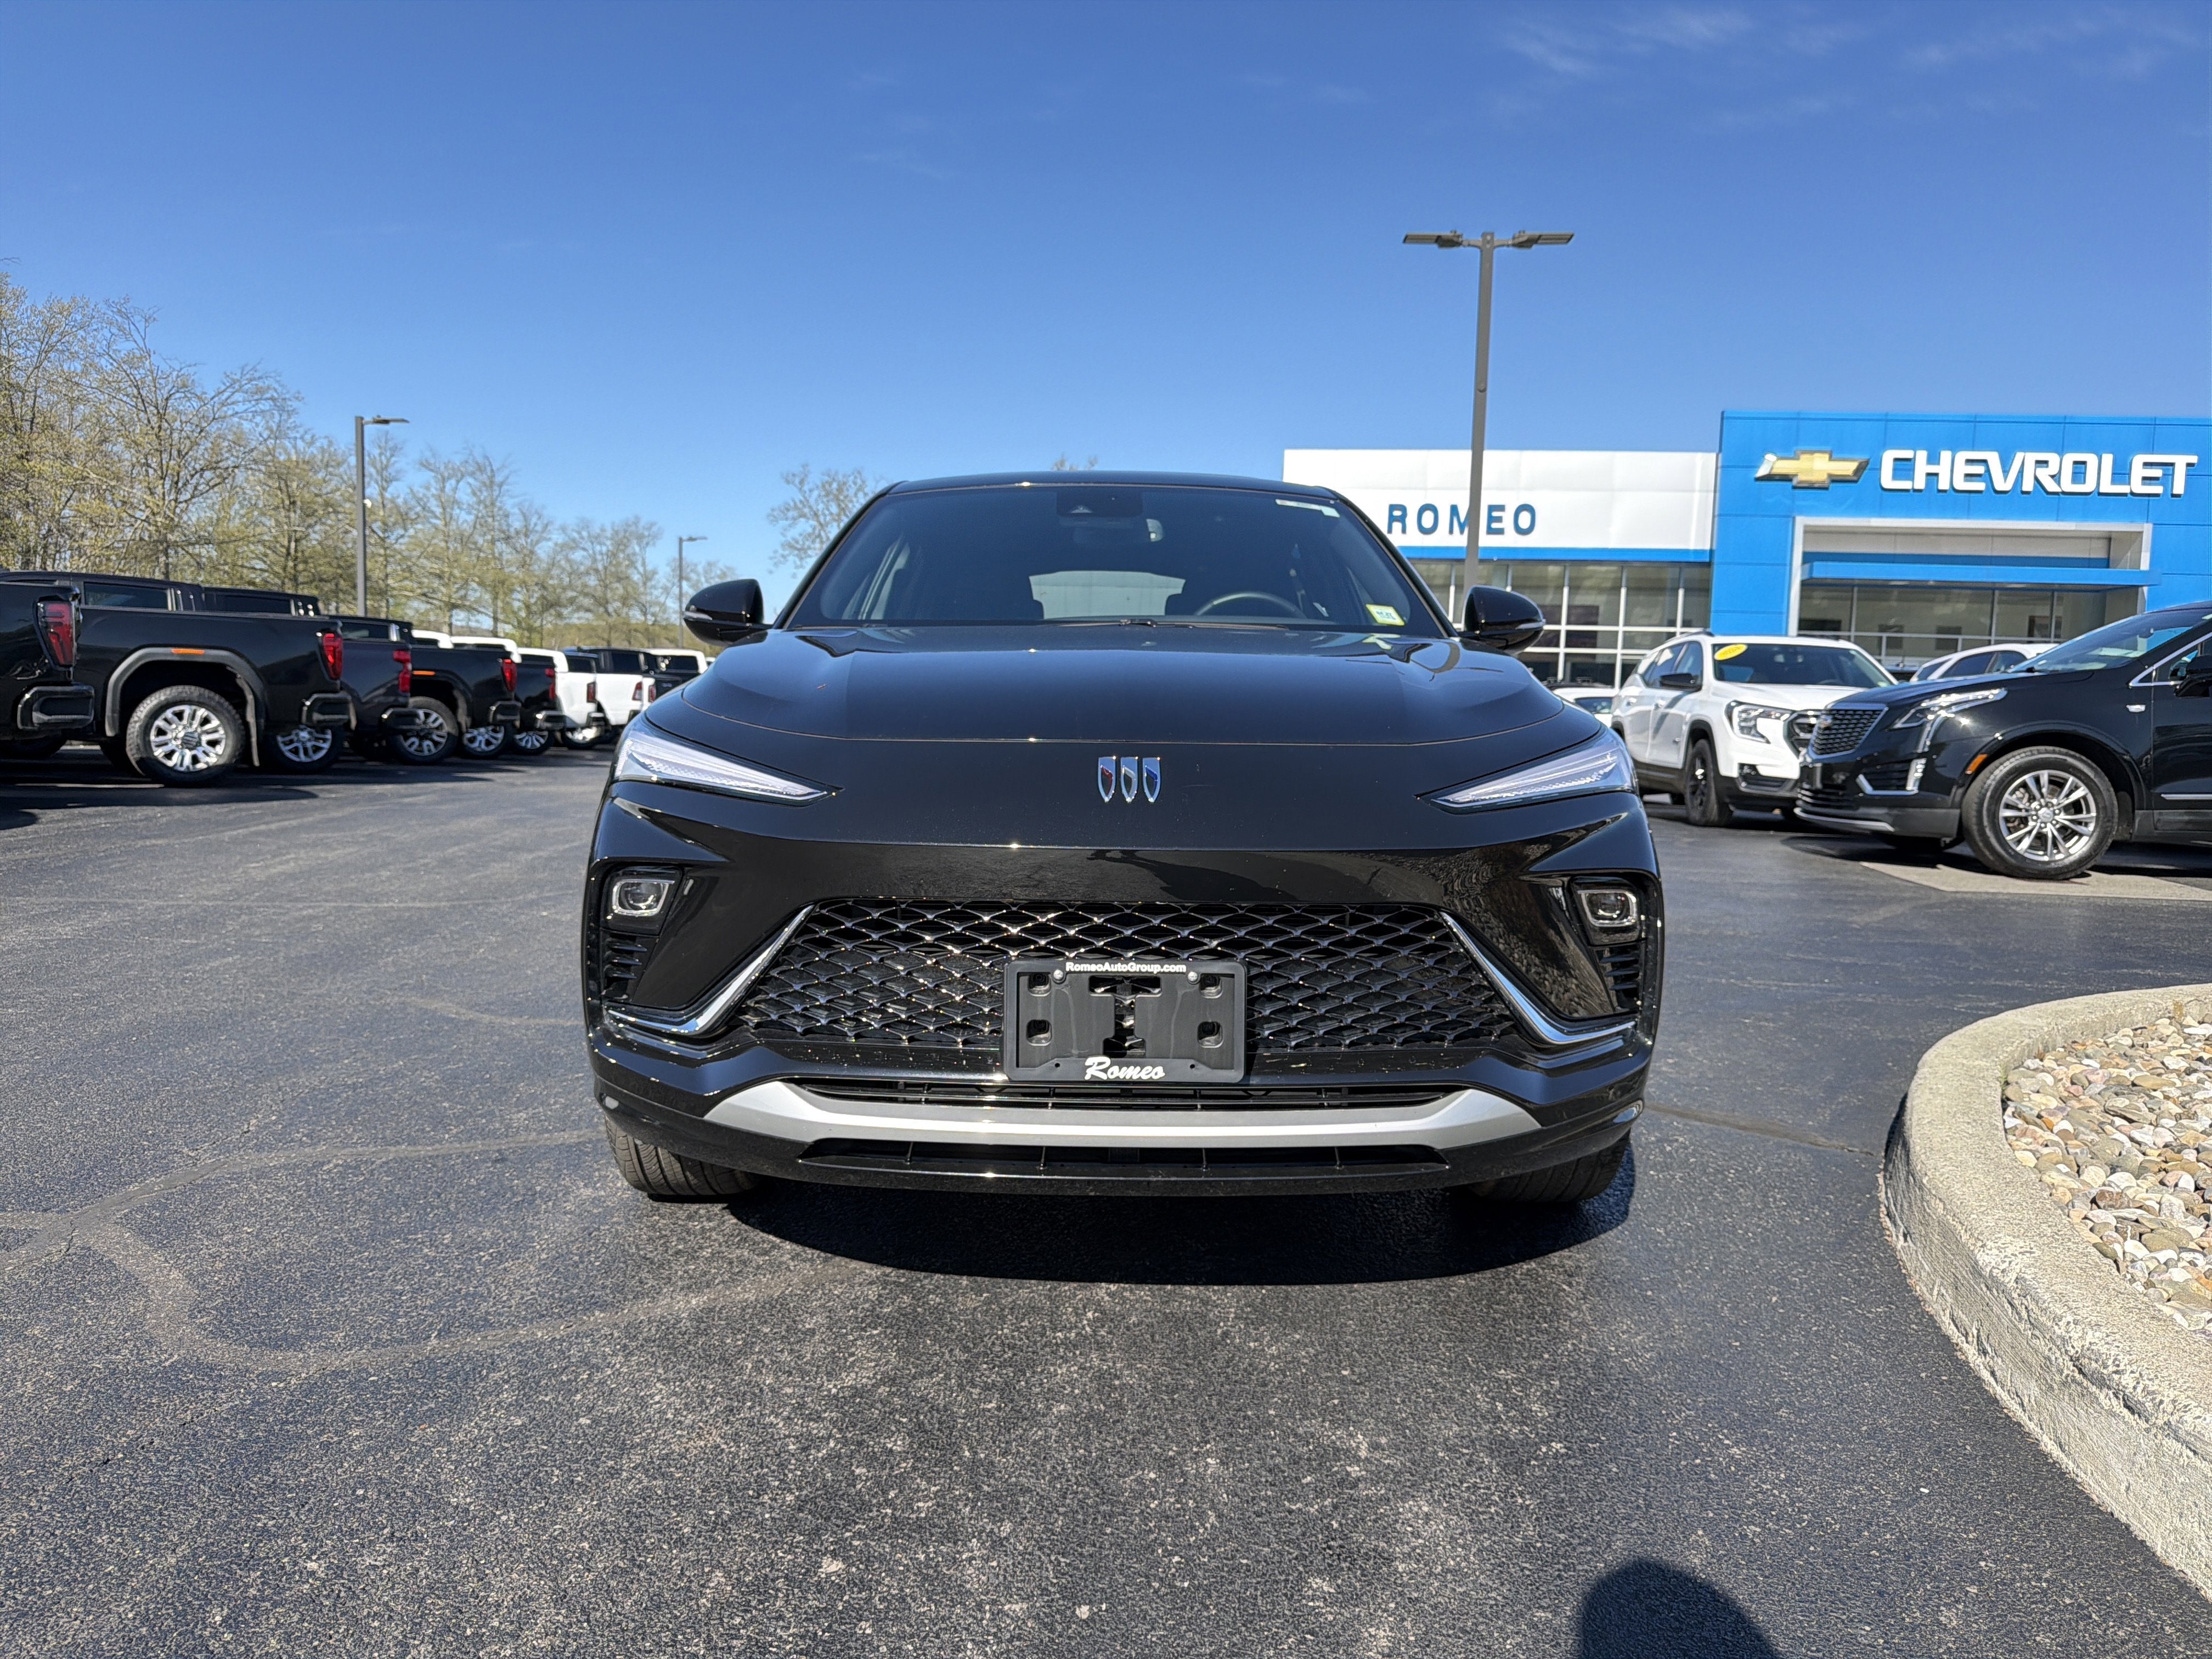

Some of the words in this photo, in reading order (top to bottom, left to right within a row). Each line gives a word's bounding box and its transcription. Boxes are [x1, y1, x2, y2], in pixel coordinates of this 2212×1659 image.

[1880, 449, 2198, 497] CHEVROLET
[1387, 503, 1536, 535] ROMEO
[1065, 962, 1187, 974] RomeoAutoGroup.com
[1084, 1056, 1166, 1080] Romeo
